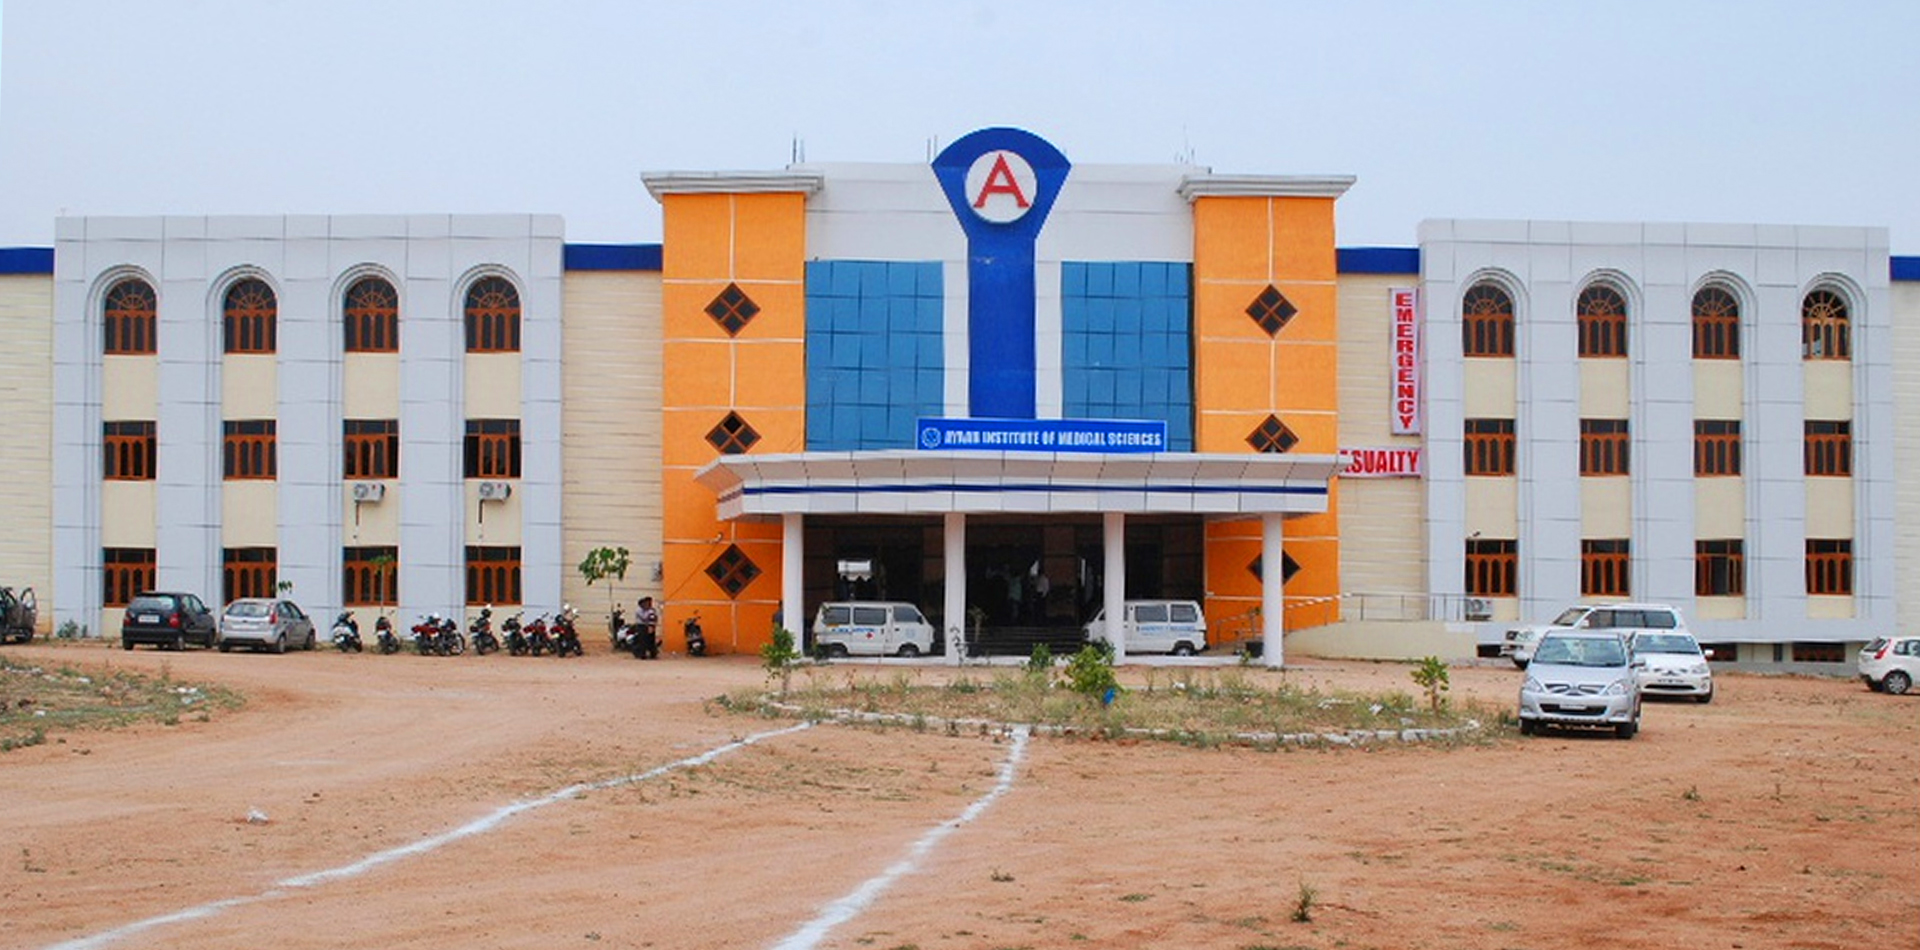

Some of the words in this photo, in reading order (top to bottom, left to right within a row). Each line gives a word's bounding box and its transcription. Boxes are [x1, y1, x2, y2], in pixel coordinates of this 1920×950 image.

[973, 152, 1030, 208] A
[1396, 293, 1414, 430] EMERGENCY
[982, 431, 1040, 445] INSTITUTE
[1042, 431, 1056, 446] OF
[1058, 431, 1107, 446] MEDICAL
[1107, 432, 1163, 446] SCIENCES
